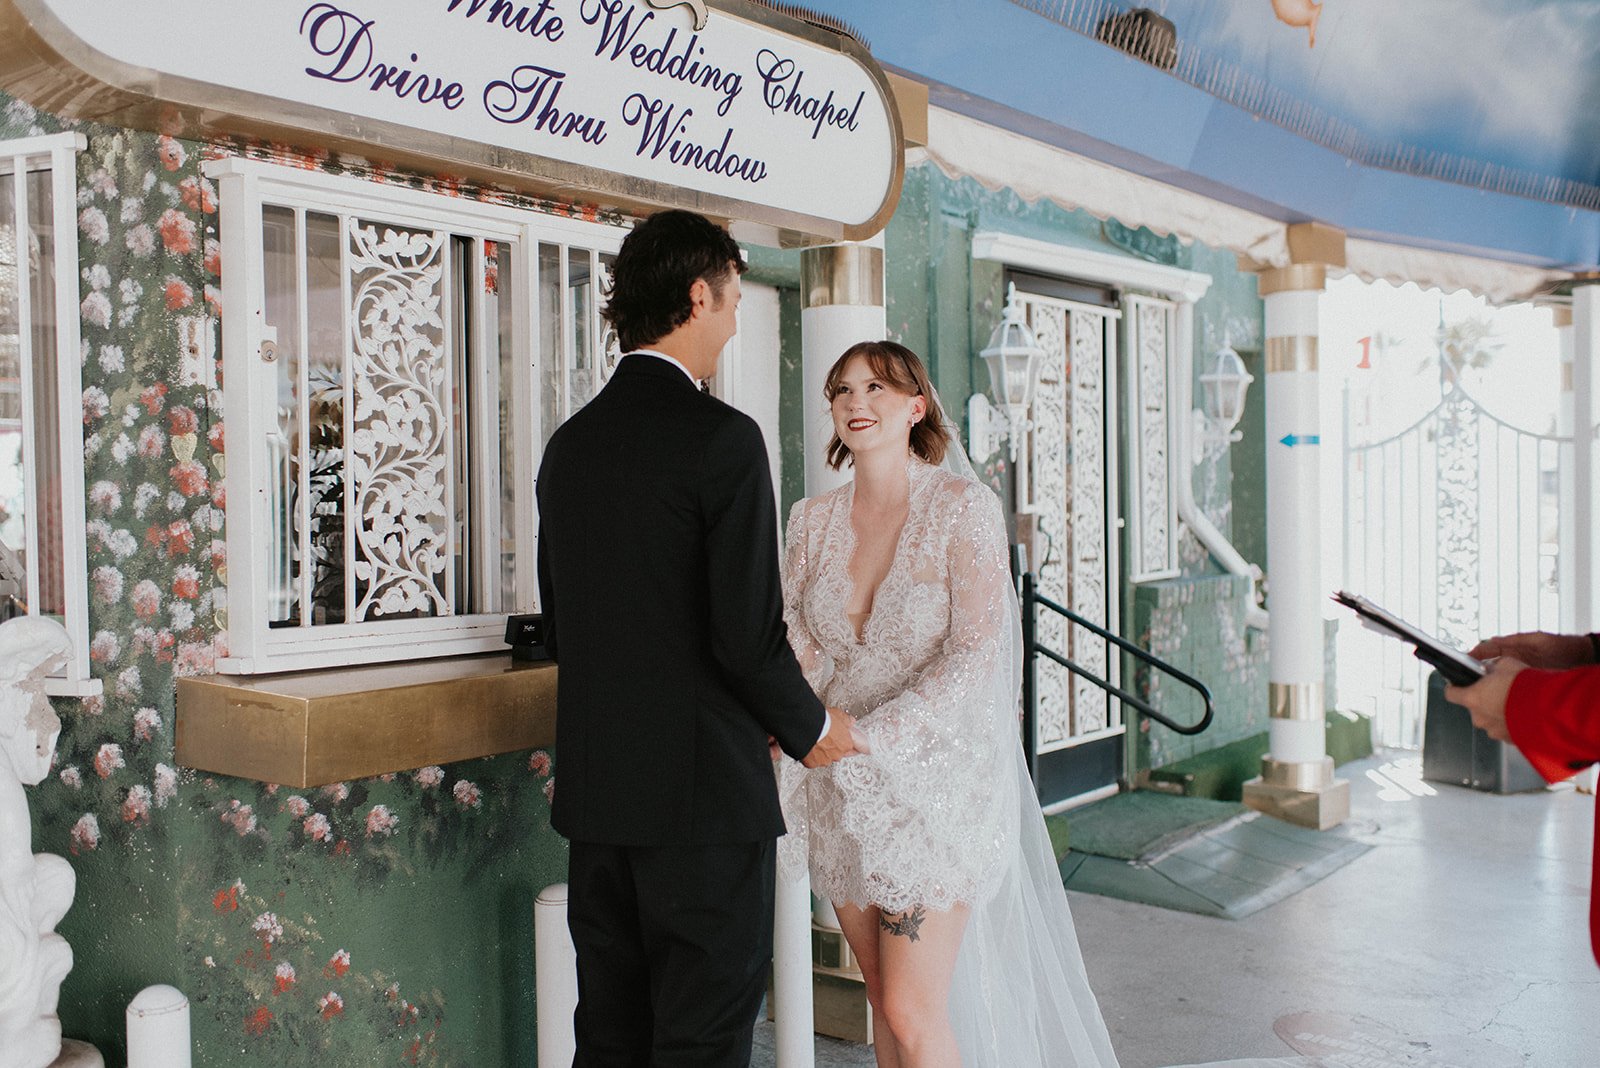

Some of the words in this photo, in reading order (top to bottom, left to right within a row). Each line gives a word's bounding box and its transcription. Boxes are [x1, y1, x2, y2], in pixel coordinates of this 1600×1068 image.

[299, 3, 465, 111] Drive
[483, 65, 608, 146] Thru
[622, 94, 768, 183] Window
[580, 0, 743, 117] Wedding
[756, 49, 866, 140] Chapel
[1356, 336, 1371, 369] 1
